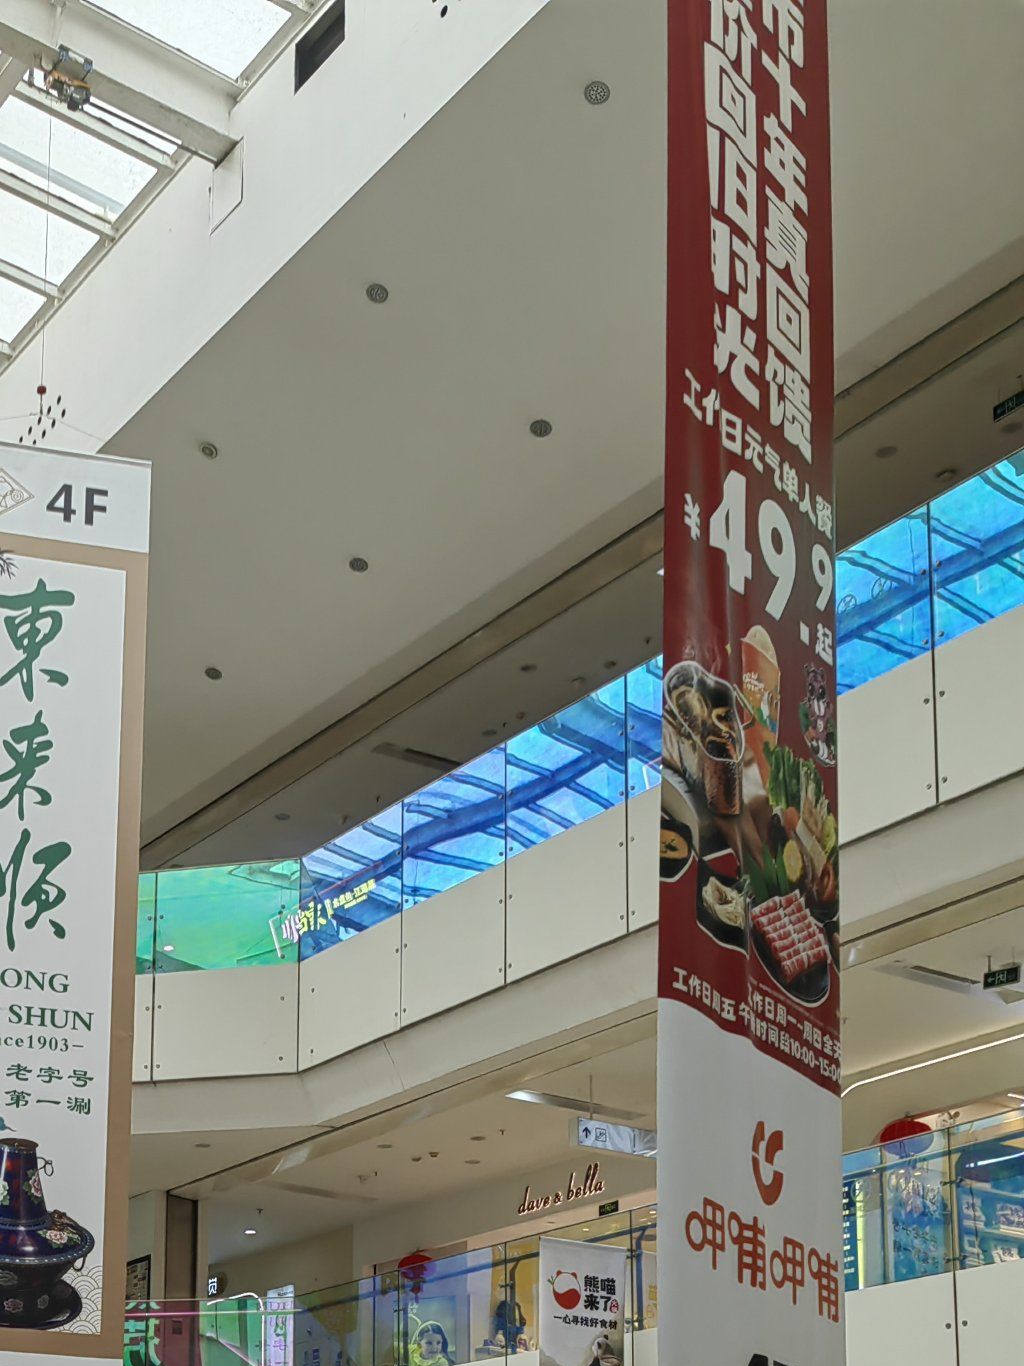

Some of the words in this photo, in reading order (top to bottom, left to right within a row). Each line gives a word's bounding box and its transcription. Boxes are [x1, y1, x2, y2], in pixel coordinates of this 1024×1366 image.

[46, 483, 109, 527] 4F
[8, 1003, 95, 1034] SHUN
[517, 1185, 551, 1216] dave
[566, 1161, 606, 1201] bella
[685, 1196, 840, 1325] 呷哺呷哺
[584, 1274, 616, 1296] 熊喵
[583, 1293, 612, 1313] 来了
[553, 1314, 618, 1331] 一心寻找好食材
